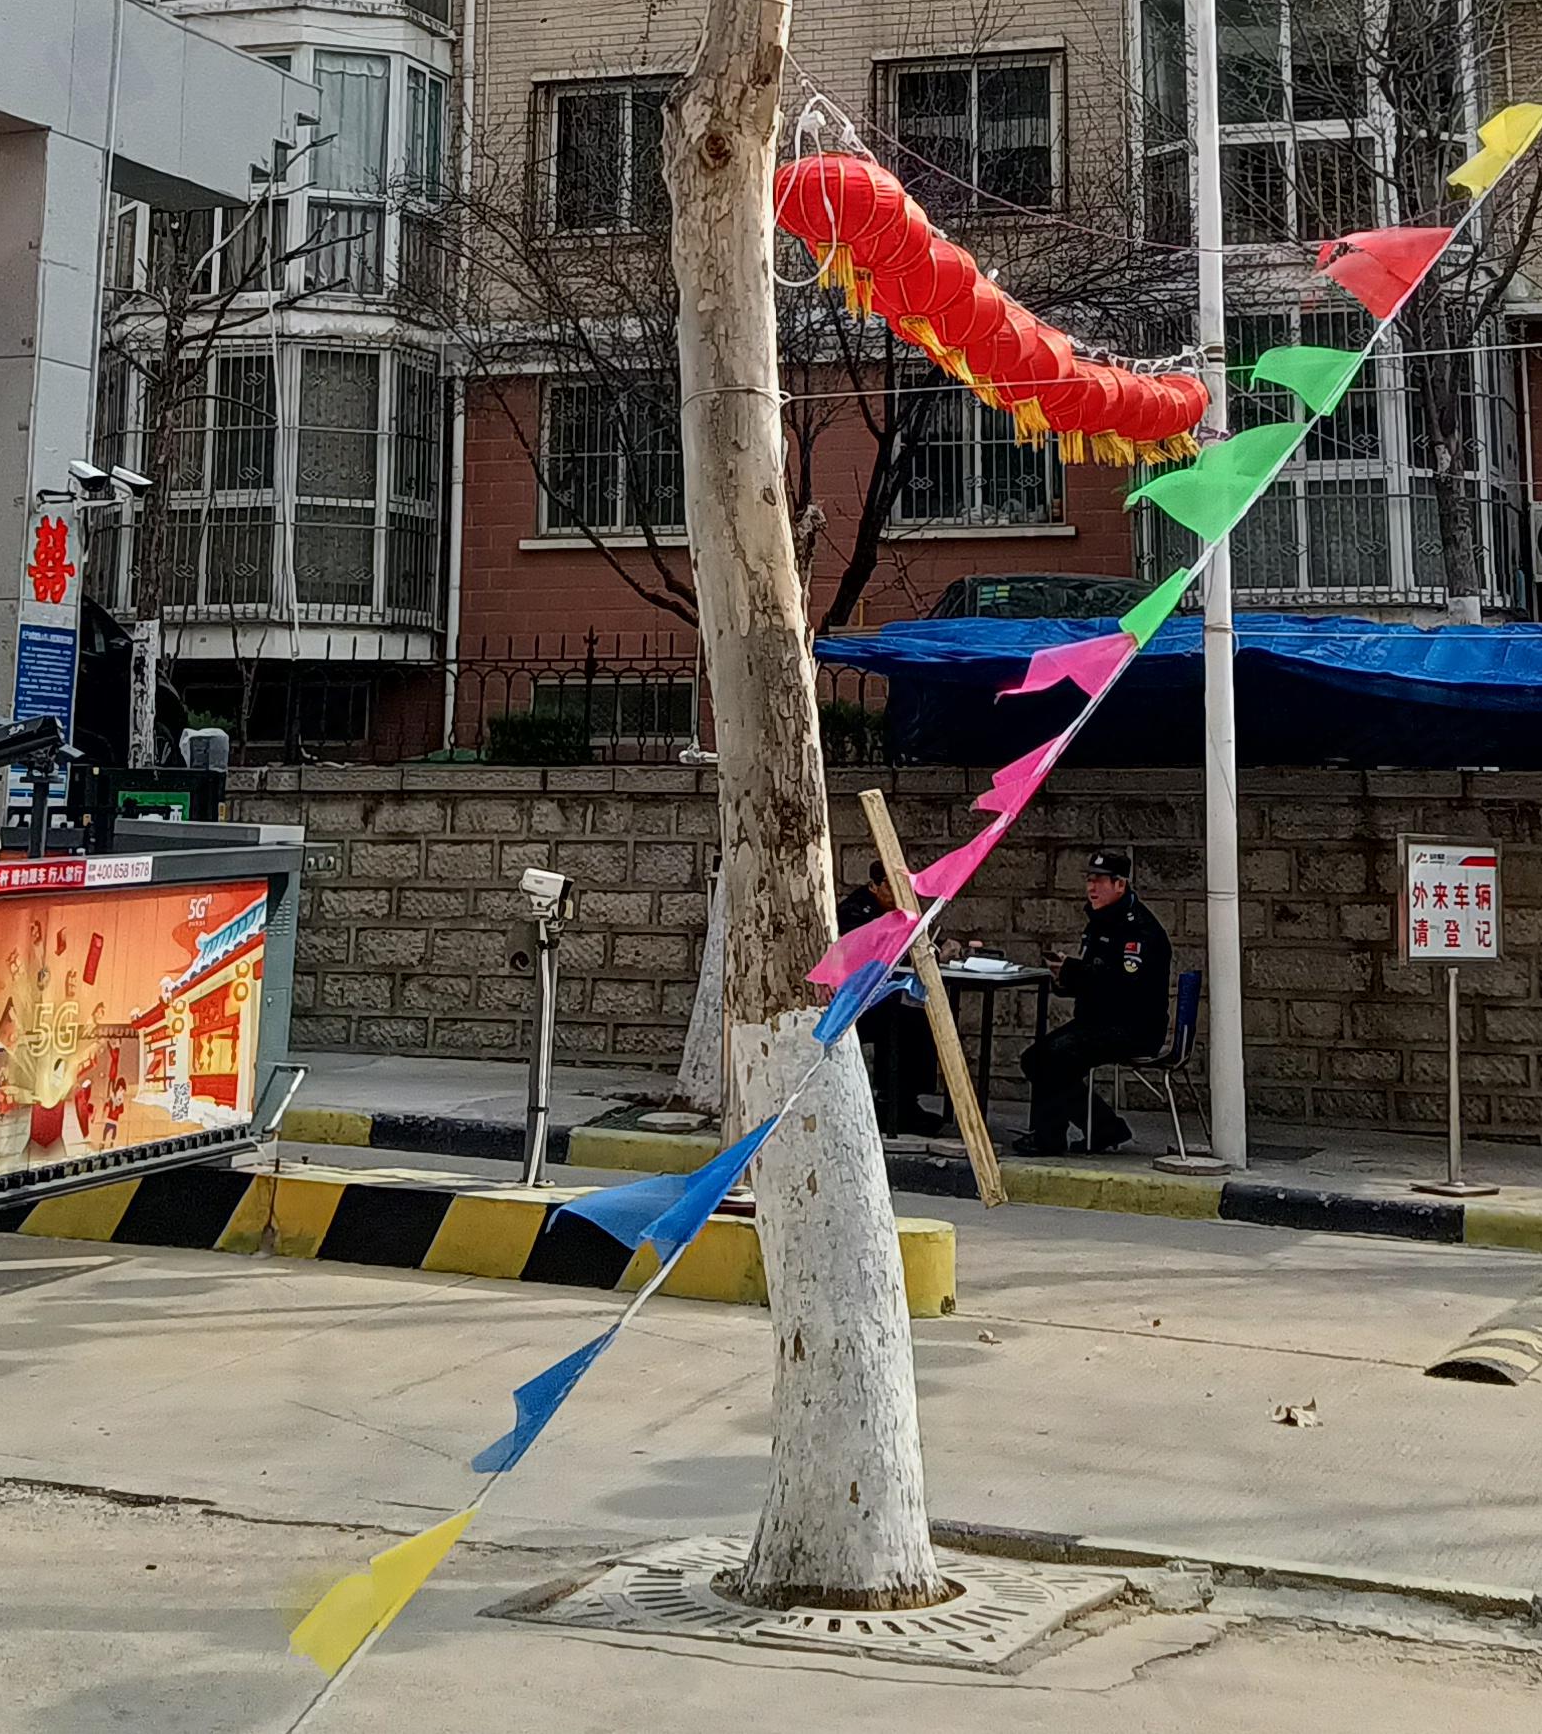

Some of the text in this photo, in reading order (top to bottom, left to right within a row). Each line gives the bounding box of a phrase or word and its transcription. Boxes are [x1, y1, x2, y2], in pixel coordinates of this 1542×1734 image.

[1412, 880, 1492, 911] 外来车辆
[1412, 918, 1492, 948] 请登记
[31, 1001, 79, 1057] 5G
